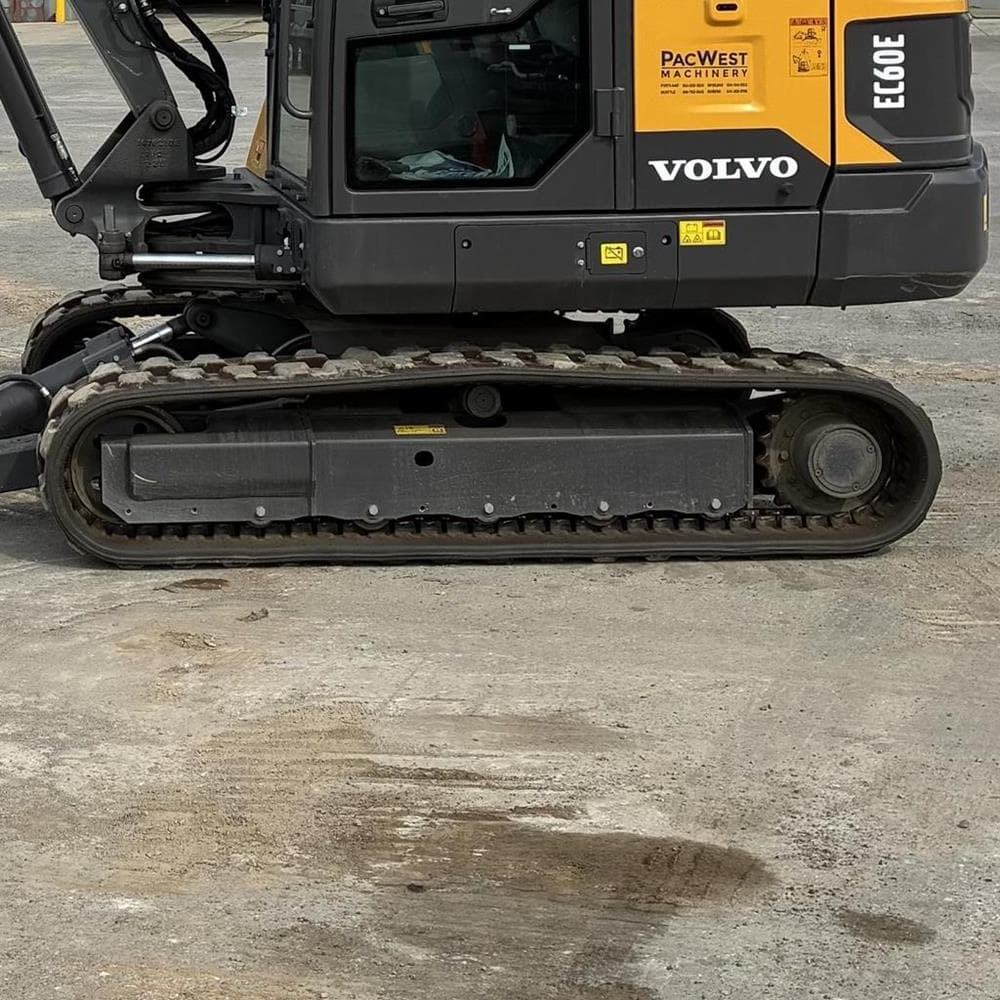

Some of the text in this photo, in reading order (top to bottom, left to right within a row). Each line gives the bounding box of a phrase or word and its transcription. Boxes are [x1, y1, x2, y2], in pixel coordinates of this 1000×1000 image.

[661, 69, 748, 79] MACHINERY
[873, 35, 905, 109] EC60E
[648, 156, 799, 182] VOLVO
